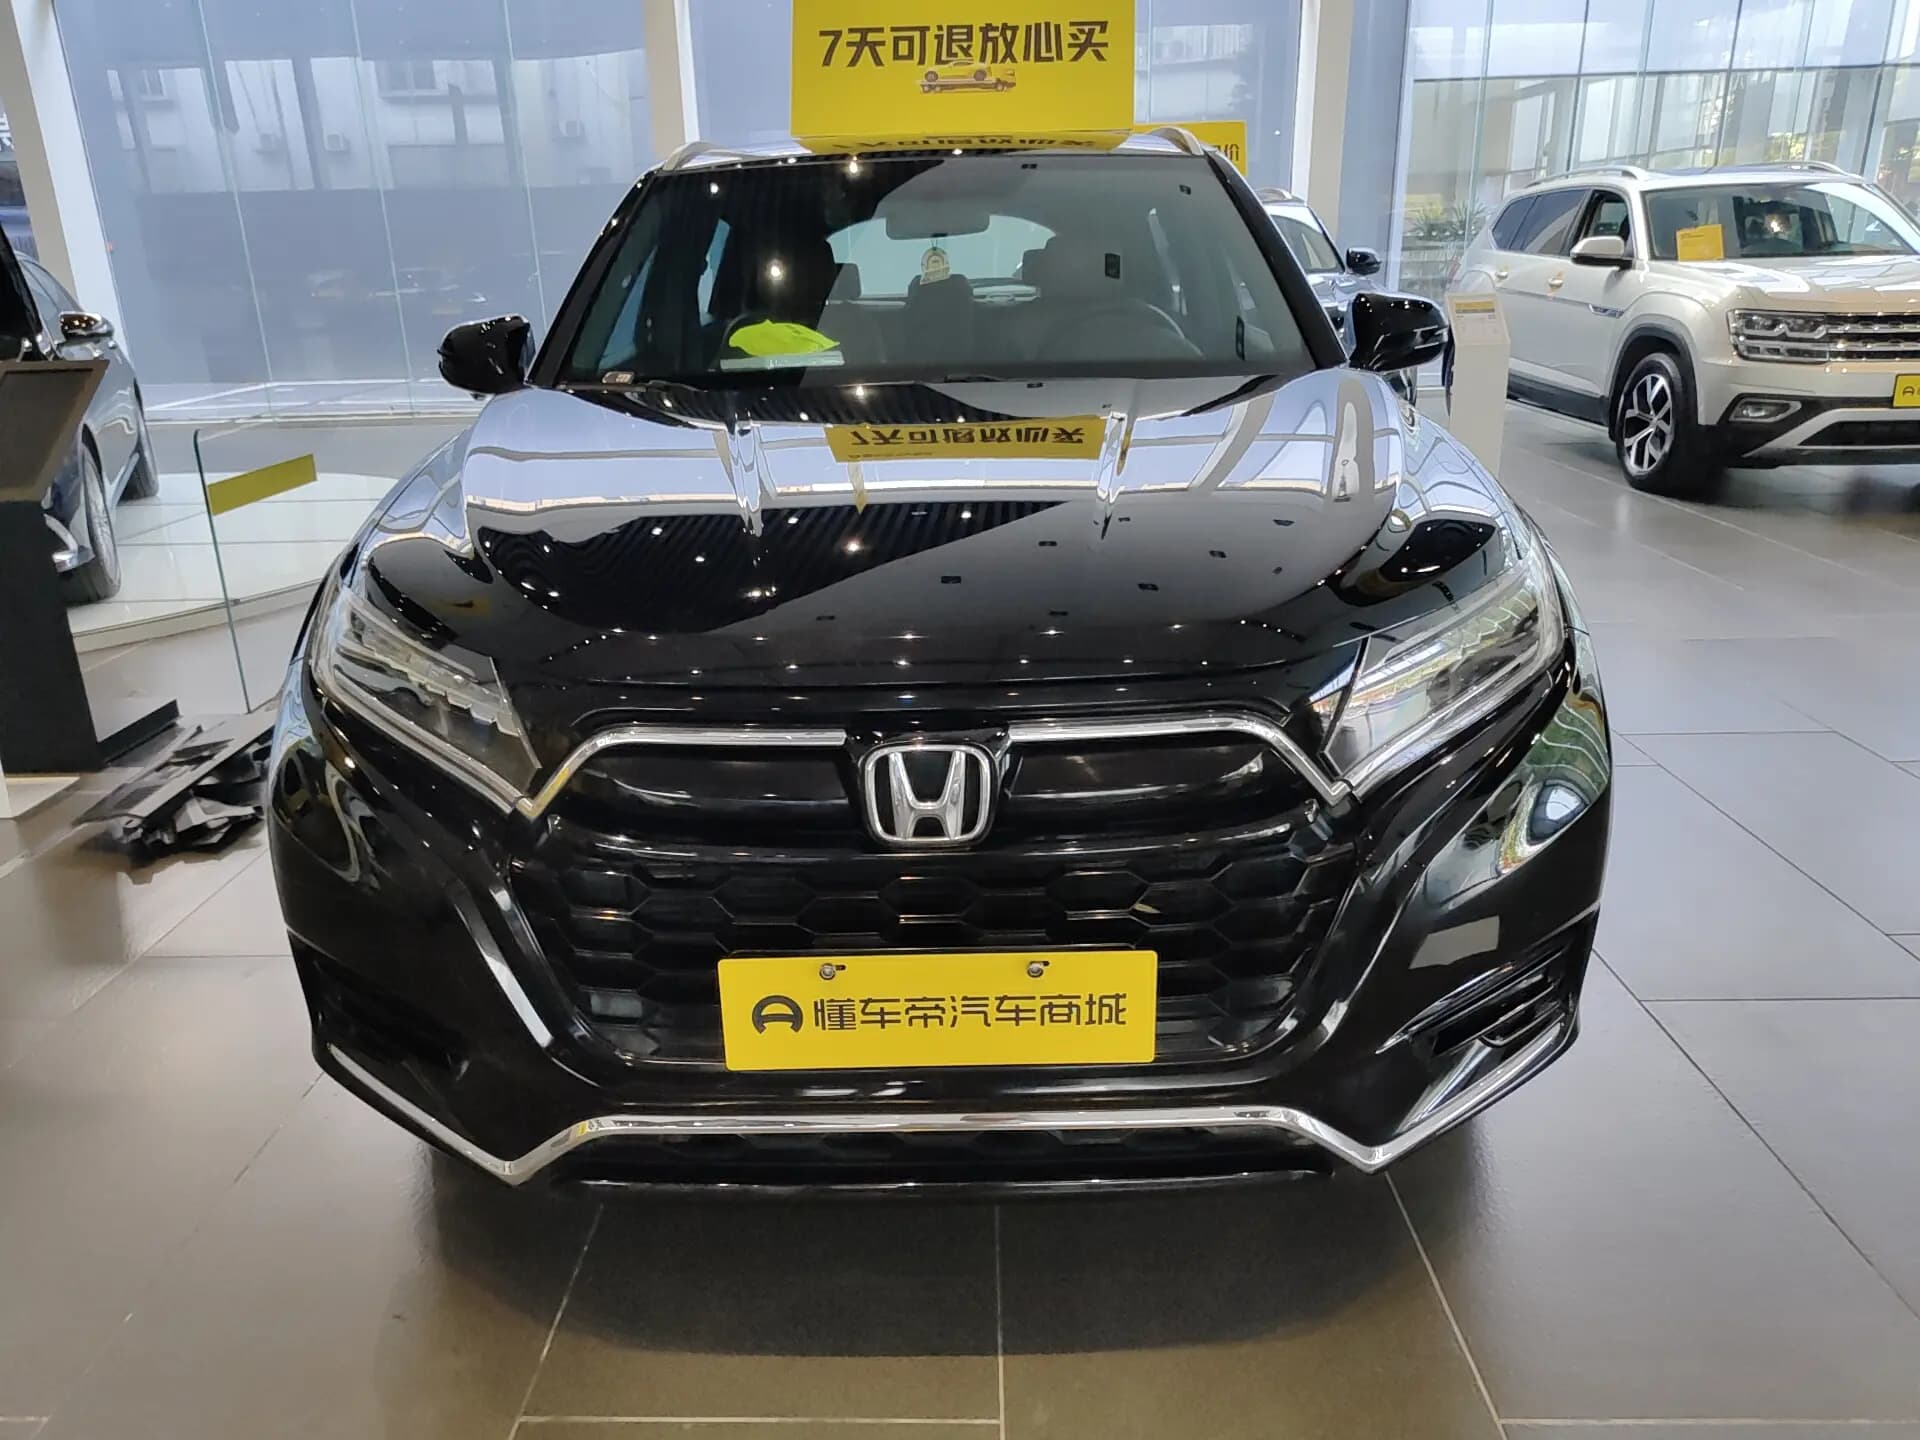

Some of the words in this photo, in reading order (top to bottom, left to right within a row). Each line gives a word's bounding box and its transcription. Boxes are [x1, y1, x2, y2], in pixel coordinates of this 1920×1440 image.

[818, 20, 1110, 68] 7天可退放心买
[813, 992, 1128, 1031] 懂车帝汽车商城
